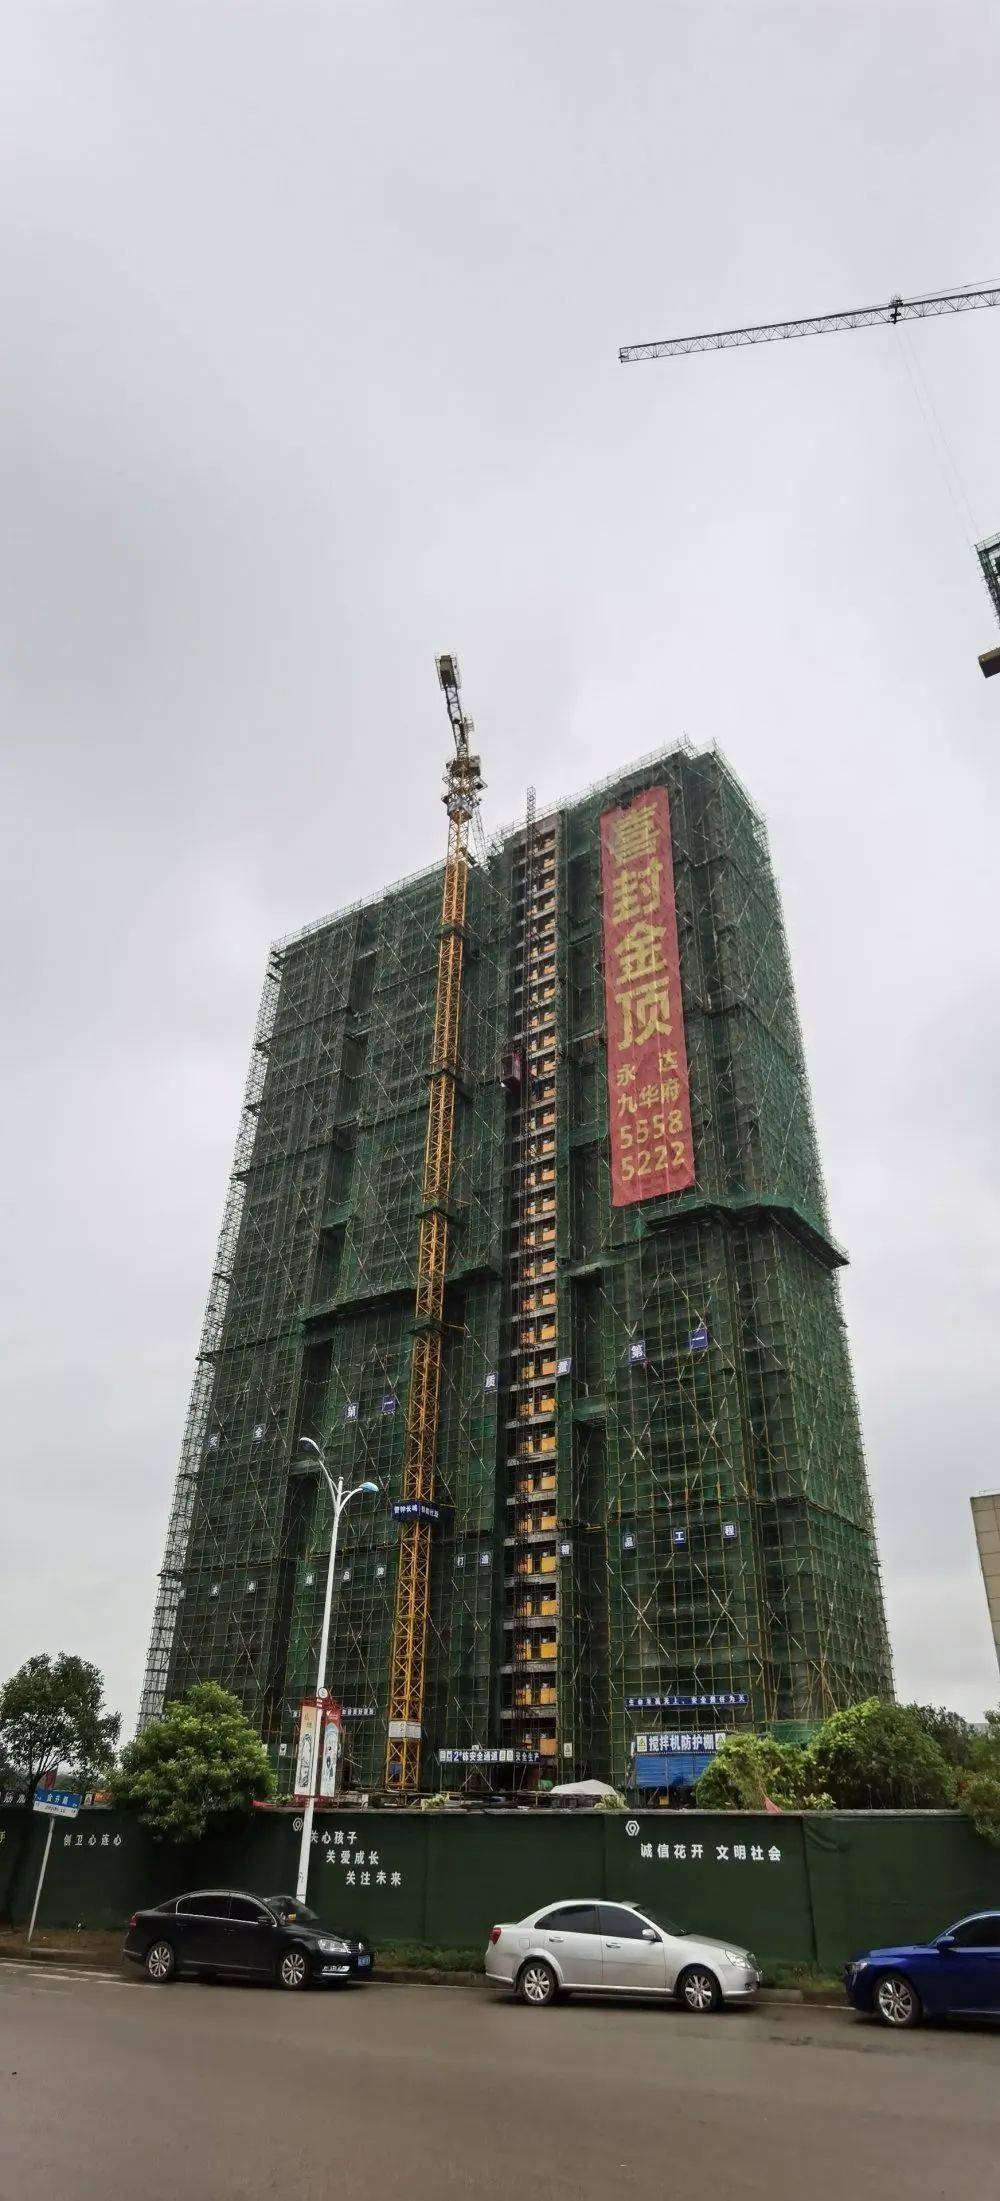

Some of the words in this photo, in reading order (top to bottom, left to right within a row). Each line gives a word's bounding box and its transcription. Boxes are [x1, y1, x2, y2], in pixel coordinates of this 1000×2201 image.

[610, 802, 673, 1051] 喜封金顶
[617, 1078, 680, 1117] 九华府
[619, 1109, 683, 1149] 5558
[621, 1141, 685, 1181] 5222
[648, 1734, 715, 1752] 搅拌机防护棚
[310, 1829, 358, 1845] 关心孩子
[326, 1849, 379, 1865] 关爱成长
[640, 1843, 704, 1859] 诚信花开
[715, 1845, 781, 1861] 文明社会
[345, 1870, 402, 1887] 关注未来
